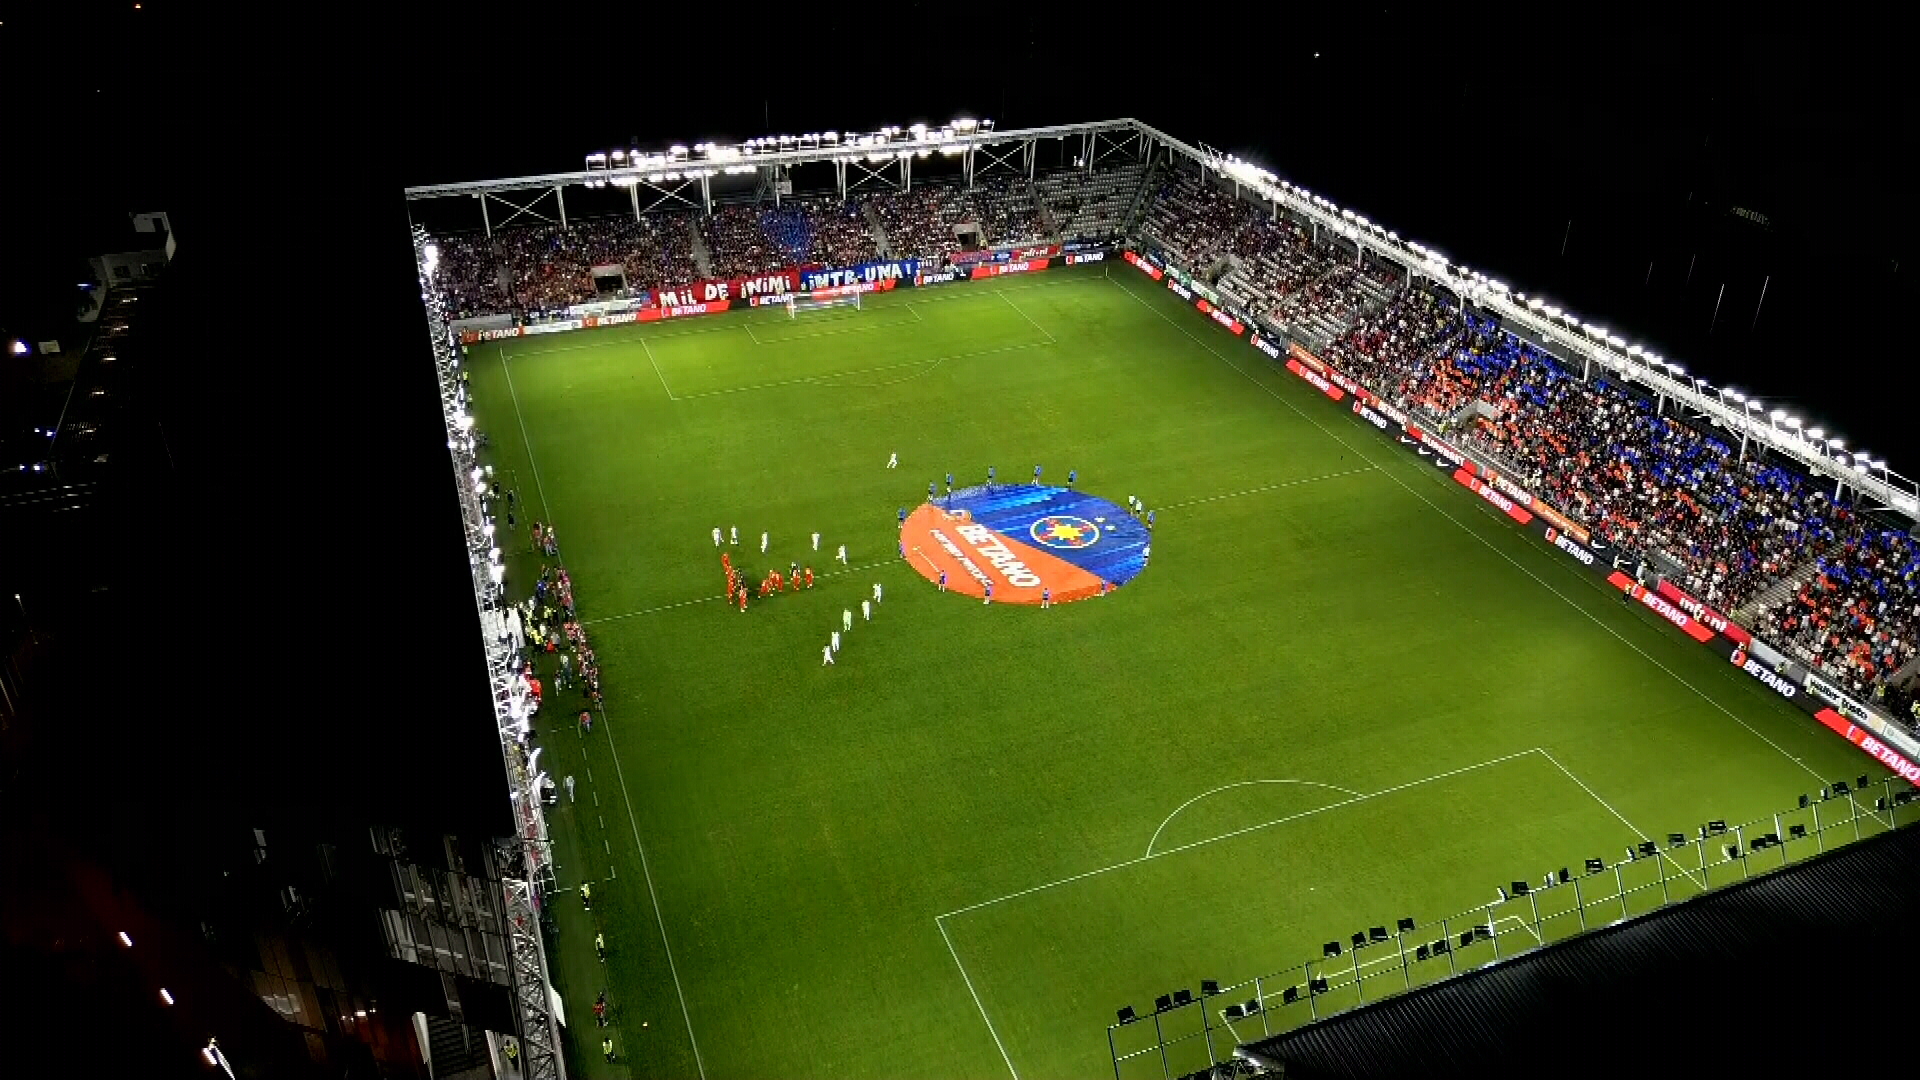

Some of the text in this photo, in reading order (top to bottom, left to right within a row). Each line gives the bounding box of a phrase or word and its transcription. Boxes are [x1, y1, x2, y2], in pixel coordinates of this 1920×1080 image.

[705, 284, 729, 300] DE
[670, 304, 707, 315] BETANO
[1304, 370, 1330, 392] BETANO
[1360, 405, 1388, 429] BETANO
[1478, 482, 1513, 512] BETANO
[1496, 476, 1532, 506] BETANO
[955, 523, 1041, 587] BETANO
[1555, 534, 1595, 566] BETANO
[1642, 591, 1689, 628] BETANO
[1743, 659, 1797, 697] BETANO
[1860, 735, 1920, 782] BETANO
